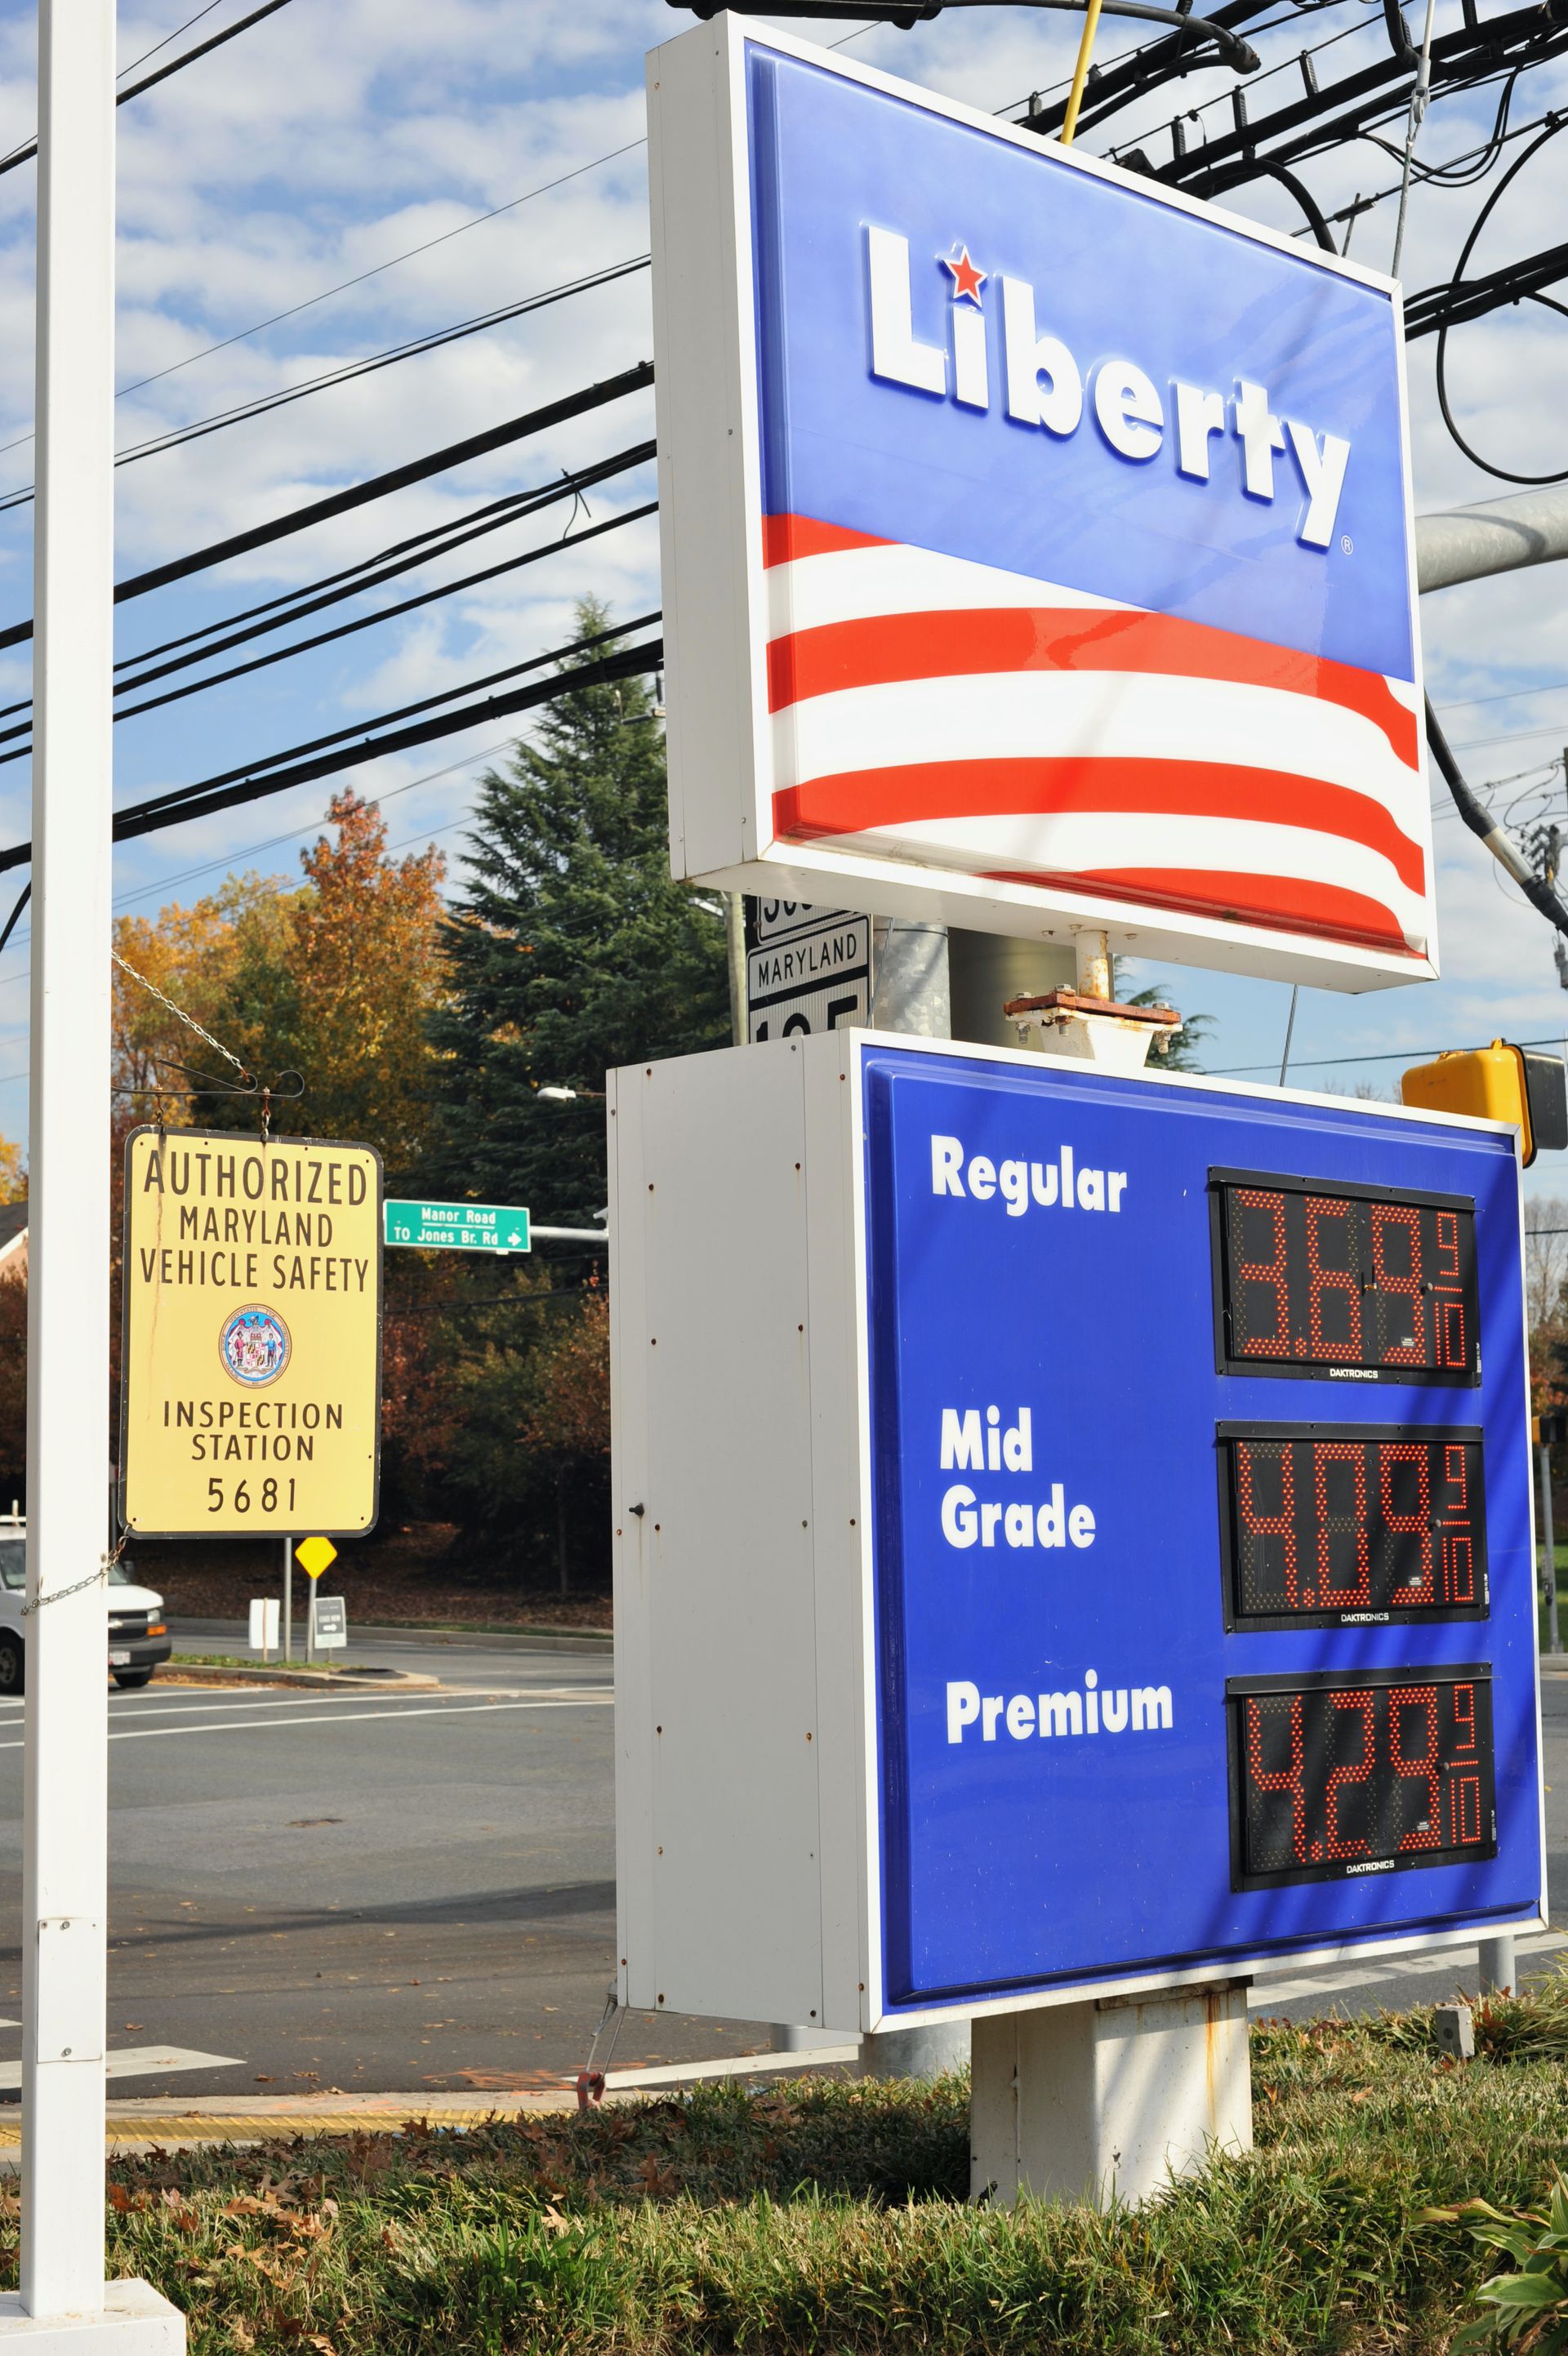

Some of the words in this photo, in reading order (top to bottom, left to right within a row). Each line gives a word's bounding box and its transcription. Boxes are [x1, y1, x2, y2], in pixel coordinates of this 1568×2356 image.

[867, 225, 1351, 547] Liberty
[759, 933, 857, 988] MARYLAND
[144, 1149, 367, 1206] AUTHORIZED
[930, 1134, 1127, 1217] Regular
[180, 1205, 332, 1248] MARYLAND
[417, 1228, 454, 1243] Jones
[461, 1230, 477, 1245] Br.
[483, 1231, 498, 1245] Rd
[421, 1207, 460, 1222] Manor
[466, 1209, 496, 1225] Road
[140, 1248, 258, 1288] VEHICLE
[273, 1255, 369, 1292] SAFETY
[1330, 1368, 1379, 1379] DAKTRONICS
[163, 1401, 343, 1429] INSPECTION
[191, 1434, 314, 1462] STATION
[940, 1405, 1033, 1472] Mid
[207, 1477, 296, 1513] 5681
[941, 1483, 1096, 1548] Grade
[1341, 1612, 1389, 1623] DAKTRONICS
[946, 1668, 1174, 1744] Premium
[1346, 1859, 1395, 1874] DAKTRONICS
